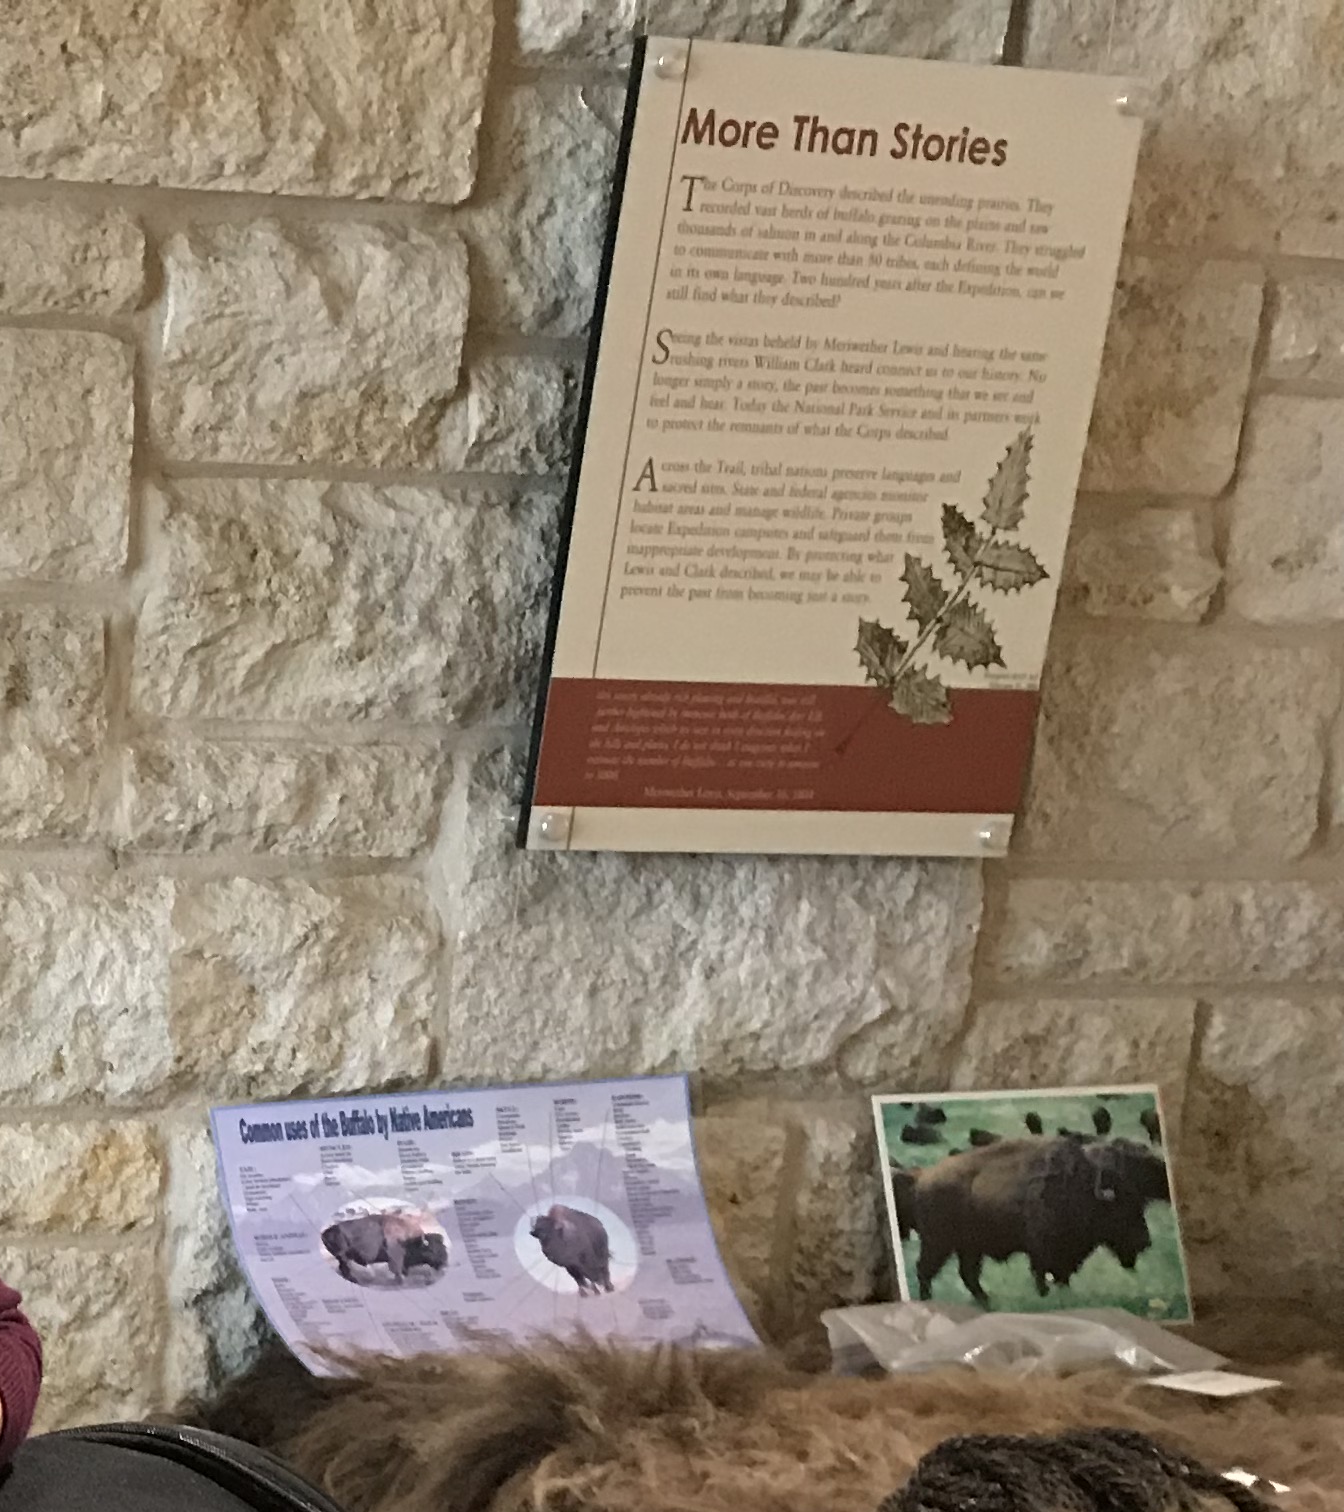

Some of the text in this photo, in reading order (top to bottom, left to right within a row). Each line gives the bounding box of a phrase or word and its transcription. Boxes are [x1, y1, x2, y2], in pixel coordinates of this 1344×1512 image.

[681, 107, 1008, 166] More Than Stories
[239, 1118, 284, 1144] Common
[284, 1120, 309, 1141] uses
[310, 1113, 320, 1138] of
[322, 1112, 339, 1138] the
[339, 1109, 375, 1136] Buffalo
[375, 1108, 389, 1140] by
[389, 1105, 421, 1133] Native
[423, 1103, 474, 1130] Americans
